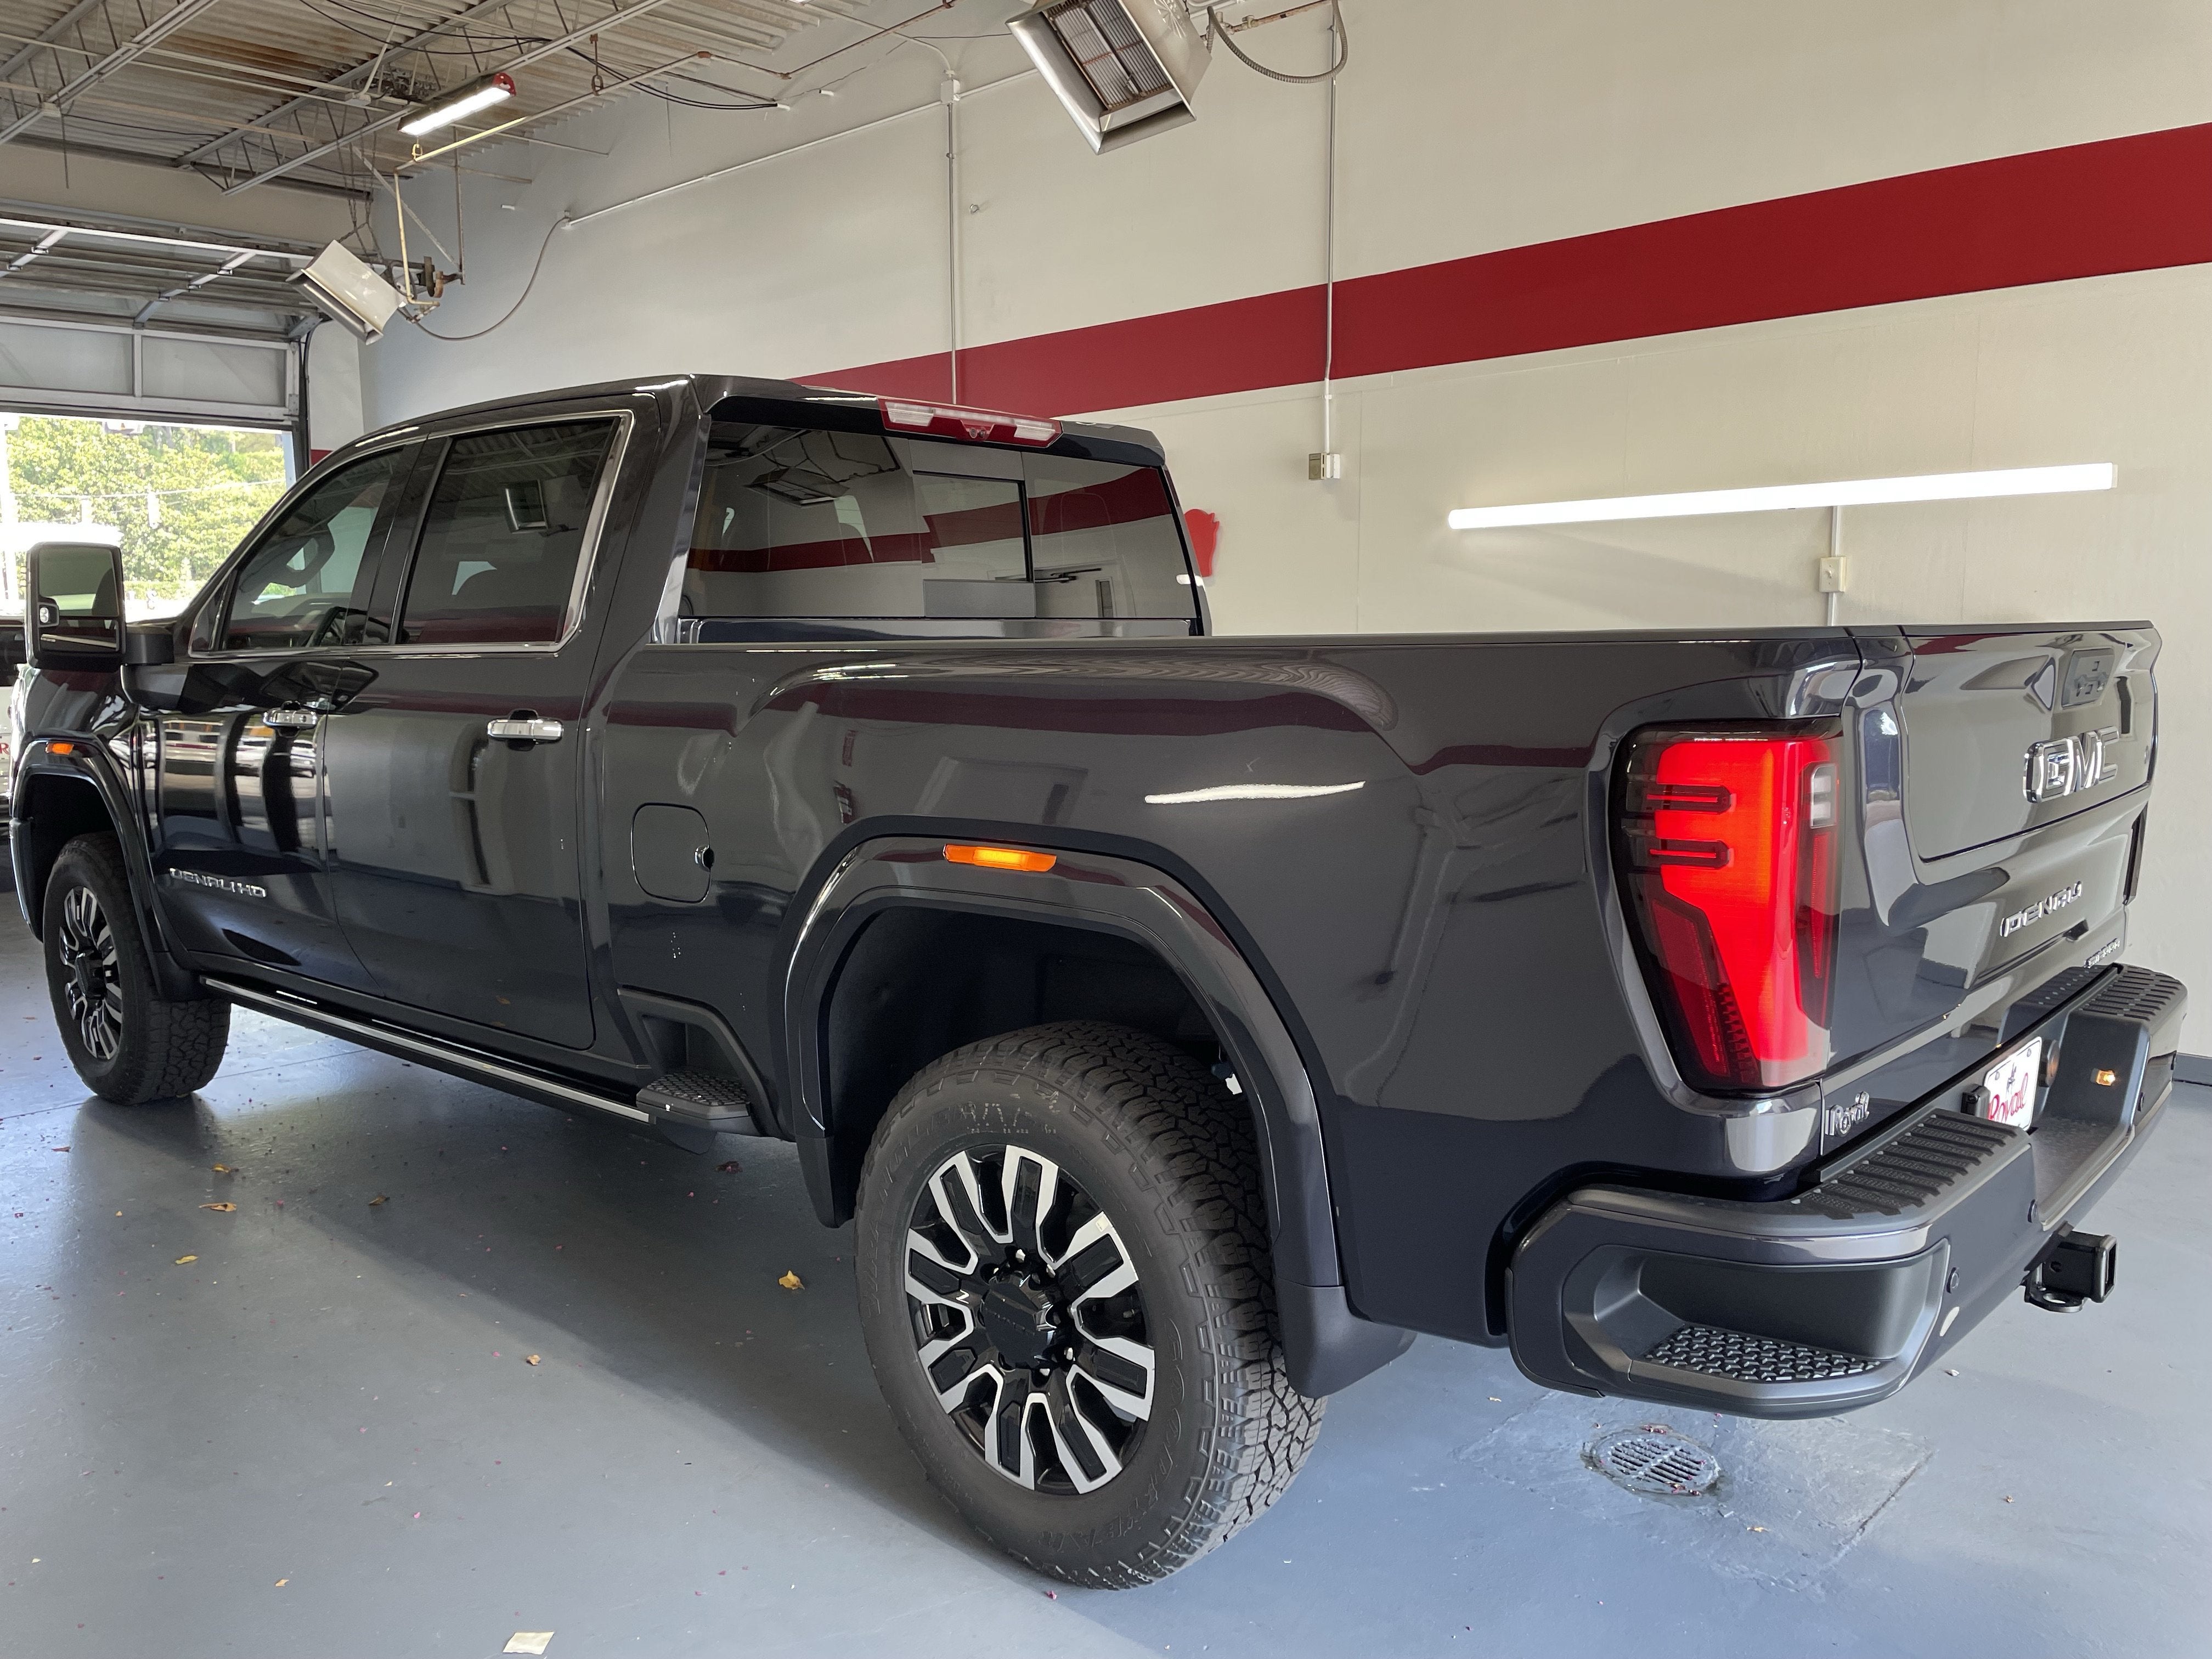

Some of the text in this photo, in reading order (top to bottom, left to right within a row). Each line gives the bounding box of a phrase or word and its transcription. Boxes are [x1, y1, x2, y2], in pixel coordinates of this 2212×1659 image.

[2023, 726, 2119, 804] GMC
[169, 868, 267, 898] DENALI HD
[2000, 881, 2083, 938] DENALI
[1825, 1091, 1870, 1137] Royal
